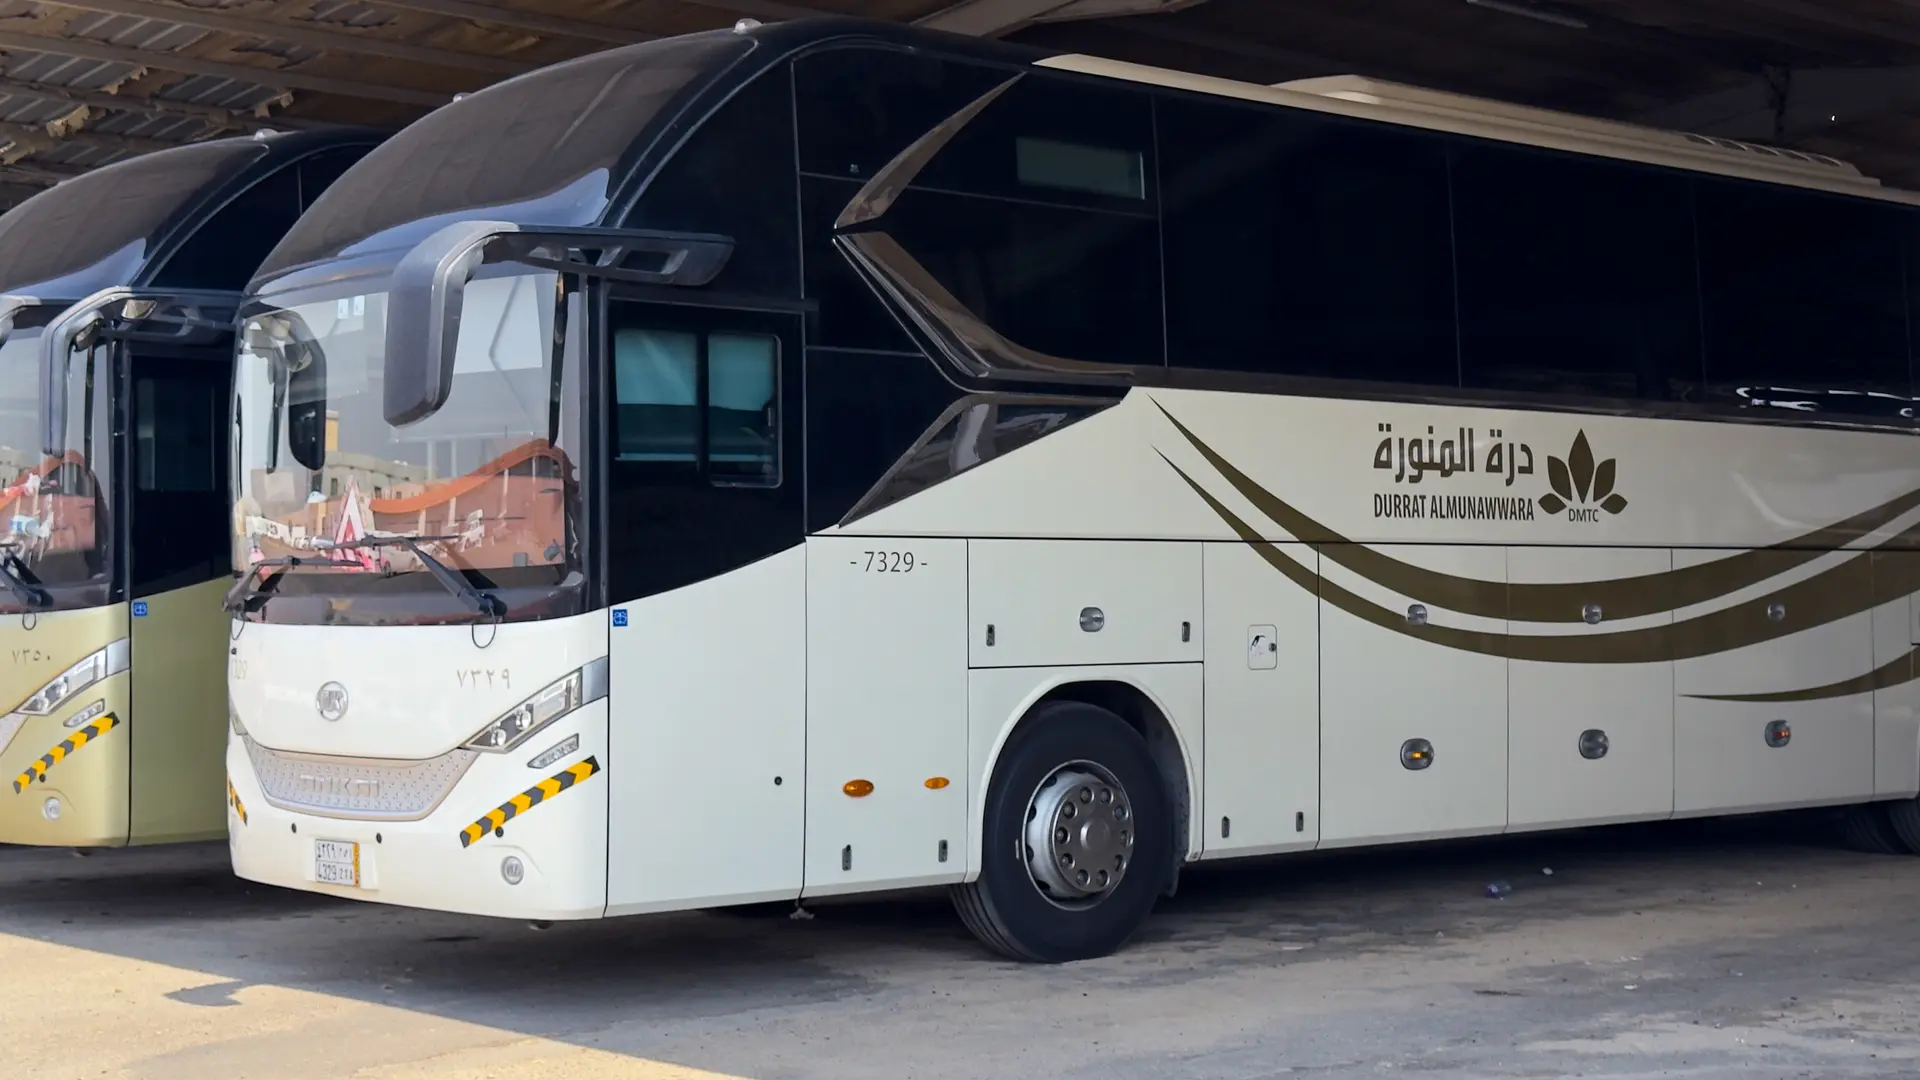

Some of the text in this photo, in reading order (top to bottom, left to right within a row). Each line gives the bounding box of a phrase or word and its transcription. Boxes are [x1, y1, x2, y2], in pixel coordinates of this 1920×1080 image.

[1373, 423, 1534, 486] درة المنورة
[1373, 493, 1535, 521] DURRAT ALMUNAWWARA
[1568, 508, 1600, 522] DMTC
[457, 668, 510, 689] ٧٣٢٩
